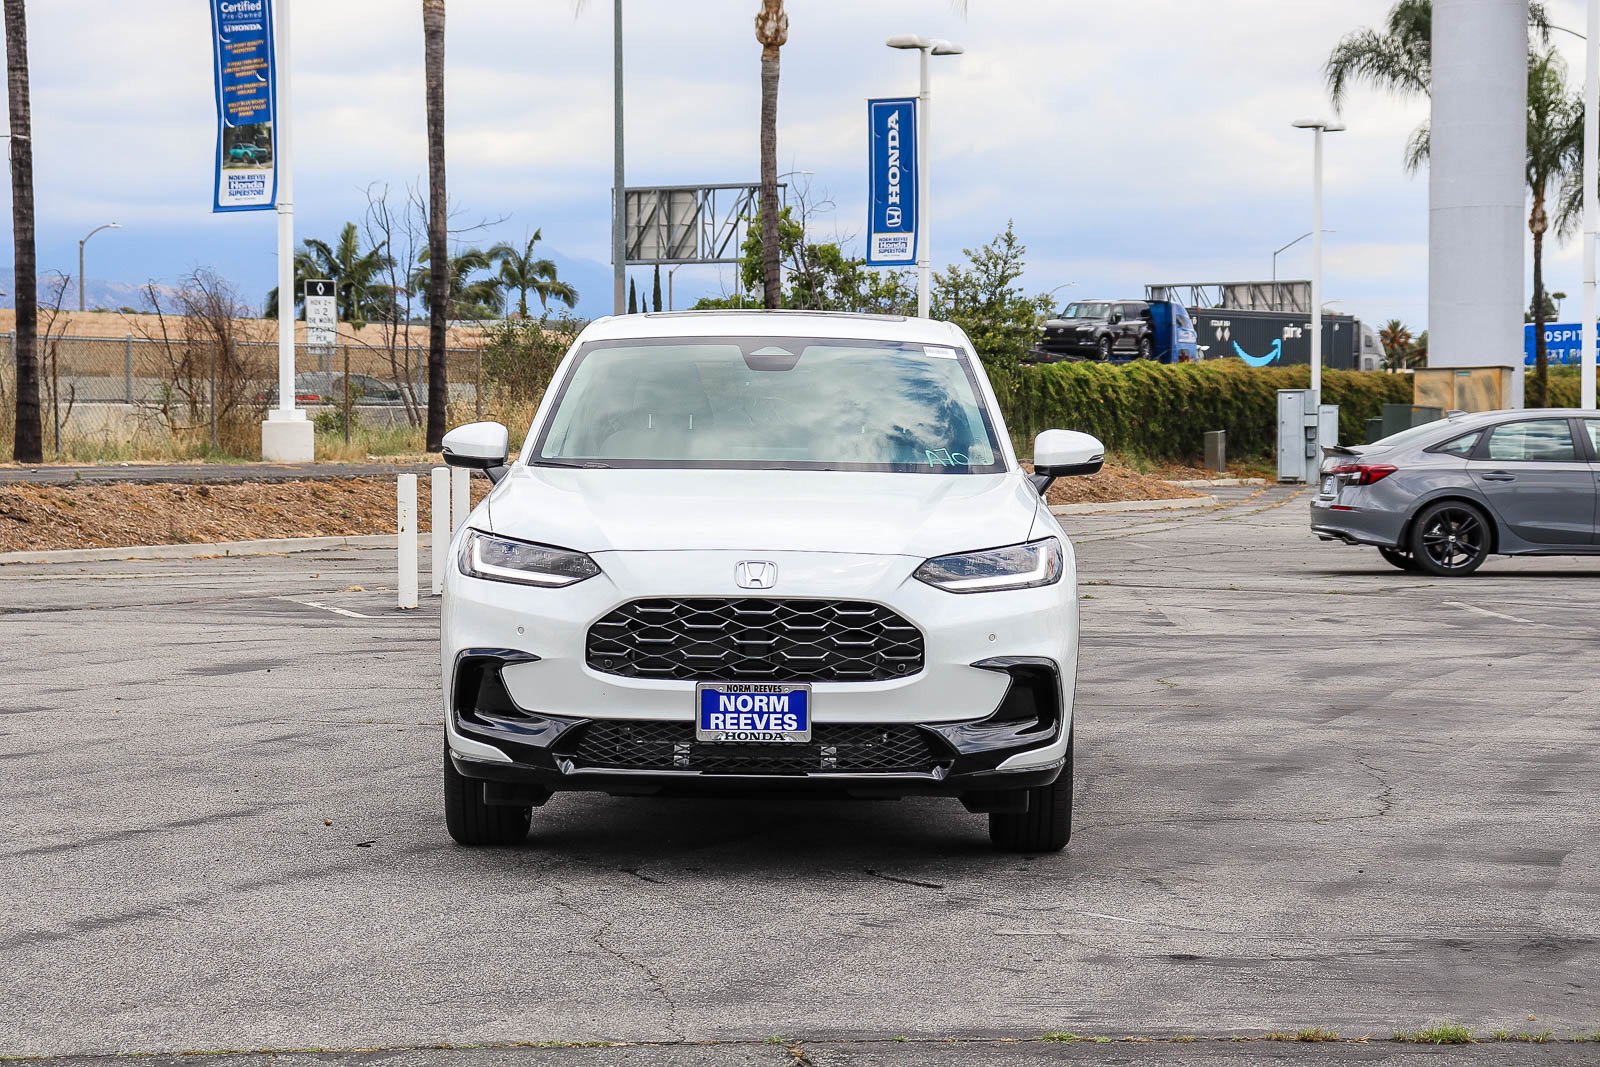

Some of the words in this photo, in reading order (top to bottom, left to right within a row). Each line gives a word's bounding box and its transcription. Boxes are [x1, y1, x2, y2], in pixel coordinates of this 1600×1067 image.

[221, 1, 262, 12] Certified
[232, 23, 263, 31] HONDA
[887, 110, 899, 205] HONDA
[230, 181, 264, 189] Honda
[726, 685, 752, 693] NORM
[754, 685, 782, 693] REEVES
[719, 695, 789, 712] NORM
[710, 713, 798, 731] REEVES
[725, 732, 786, 741] HONDA
